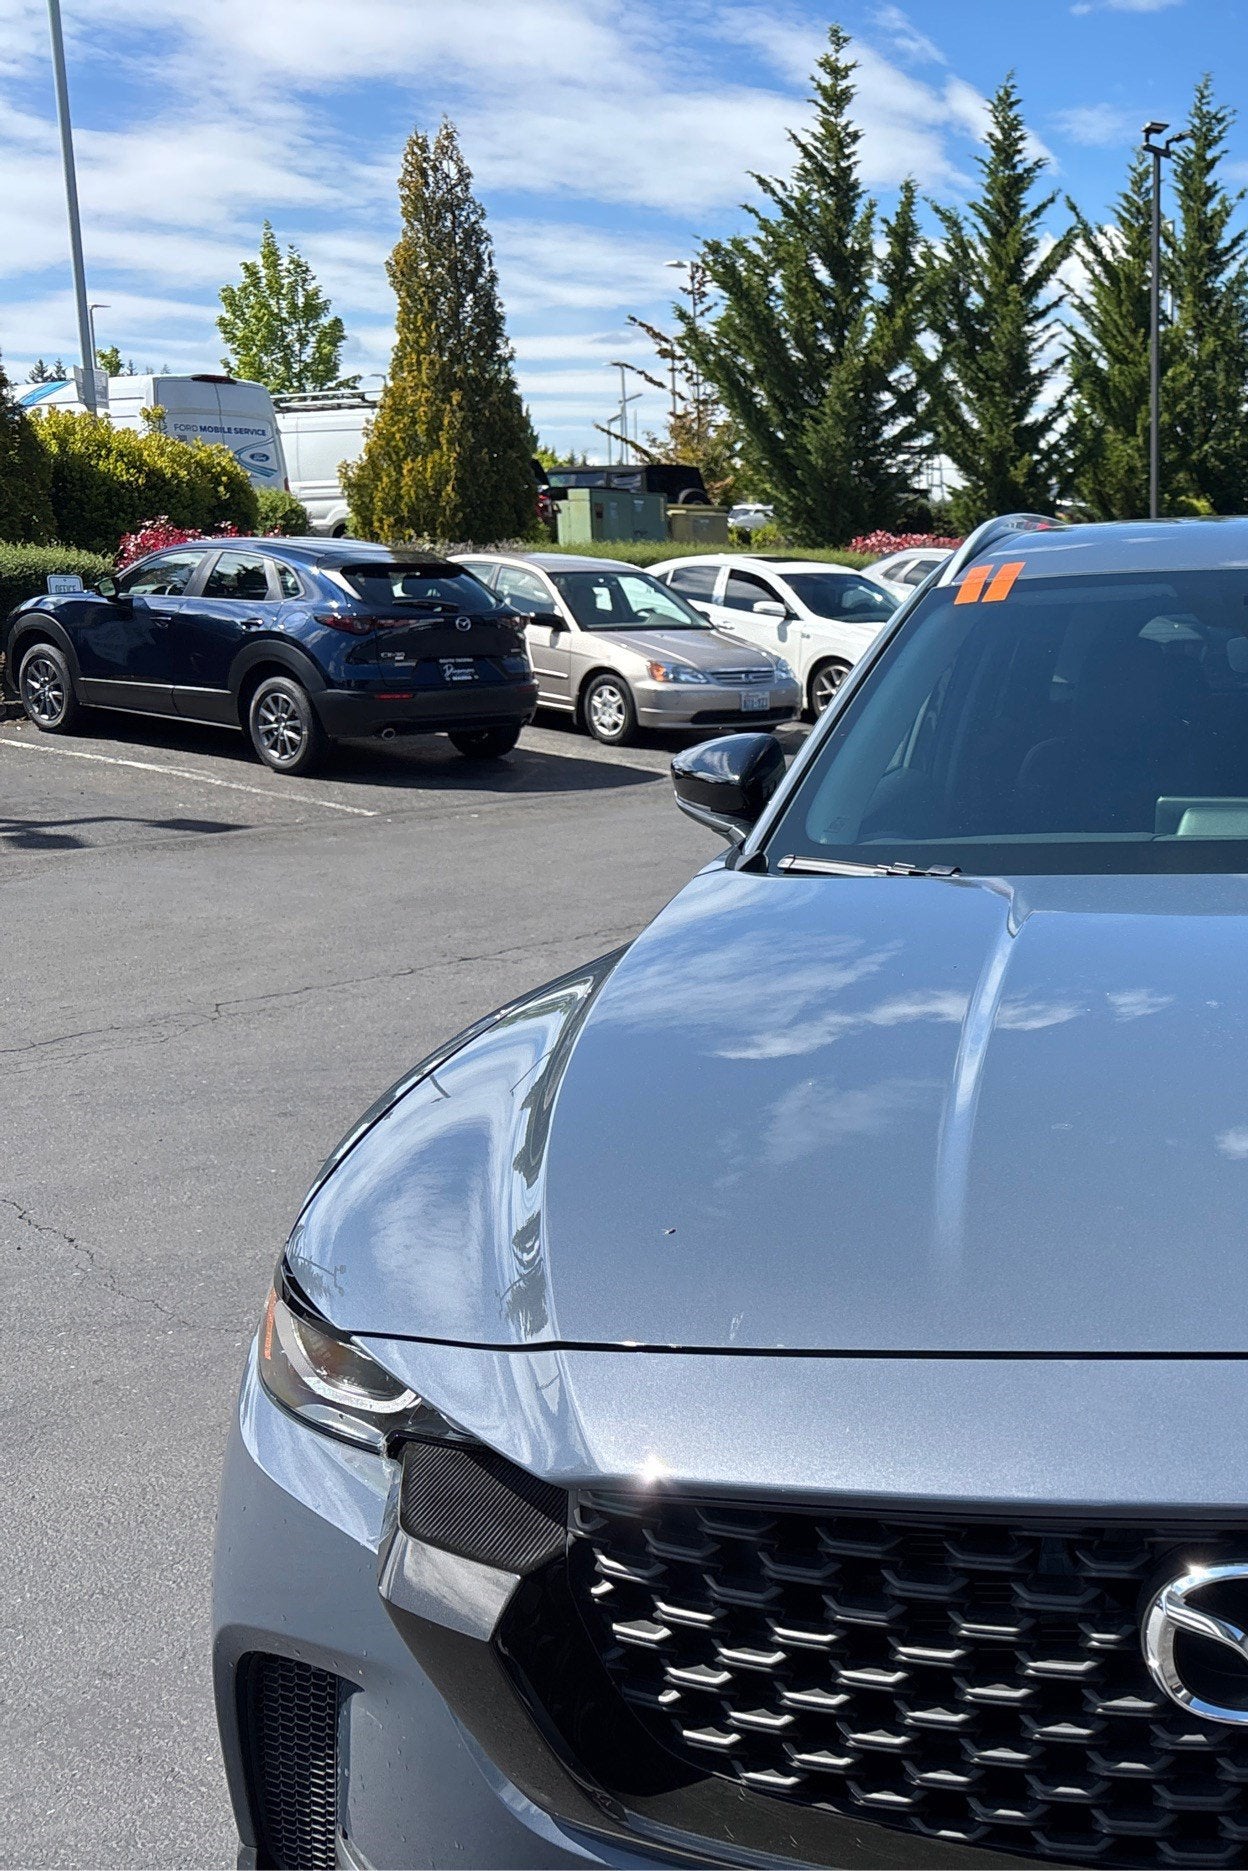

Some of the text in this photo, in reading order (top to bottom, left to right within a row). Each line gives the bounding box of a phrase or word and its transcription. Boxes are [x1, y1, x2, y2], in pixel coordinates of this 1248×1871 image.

[173, 423, 267, 436] FORD MOBILE SERVICE
